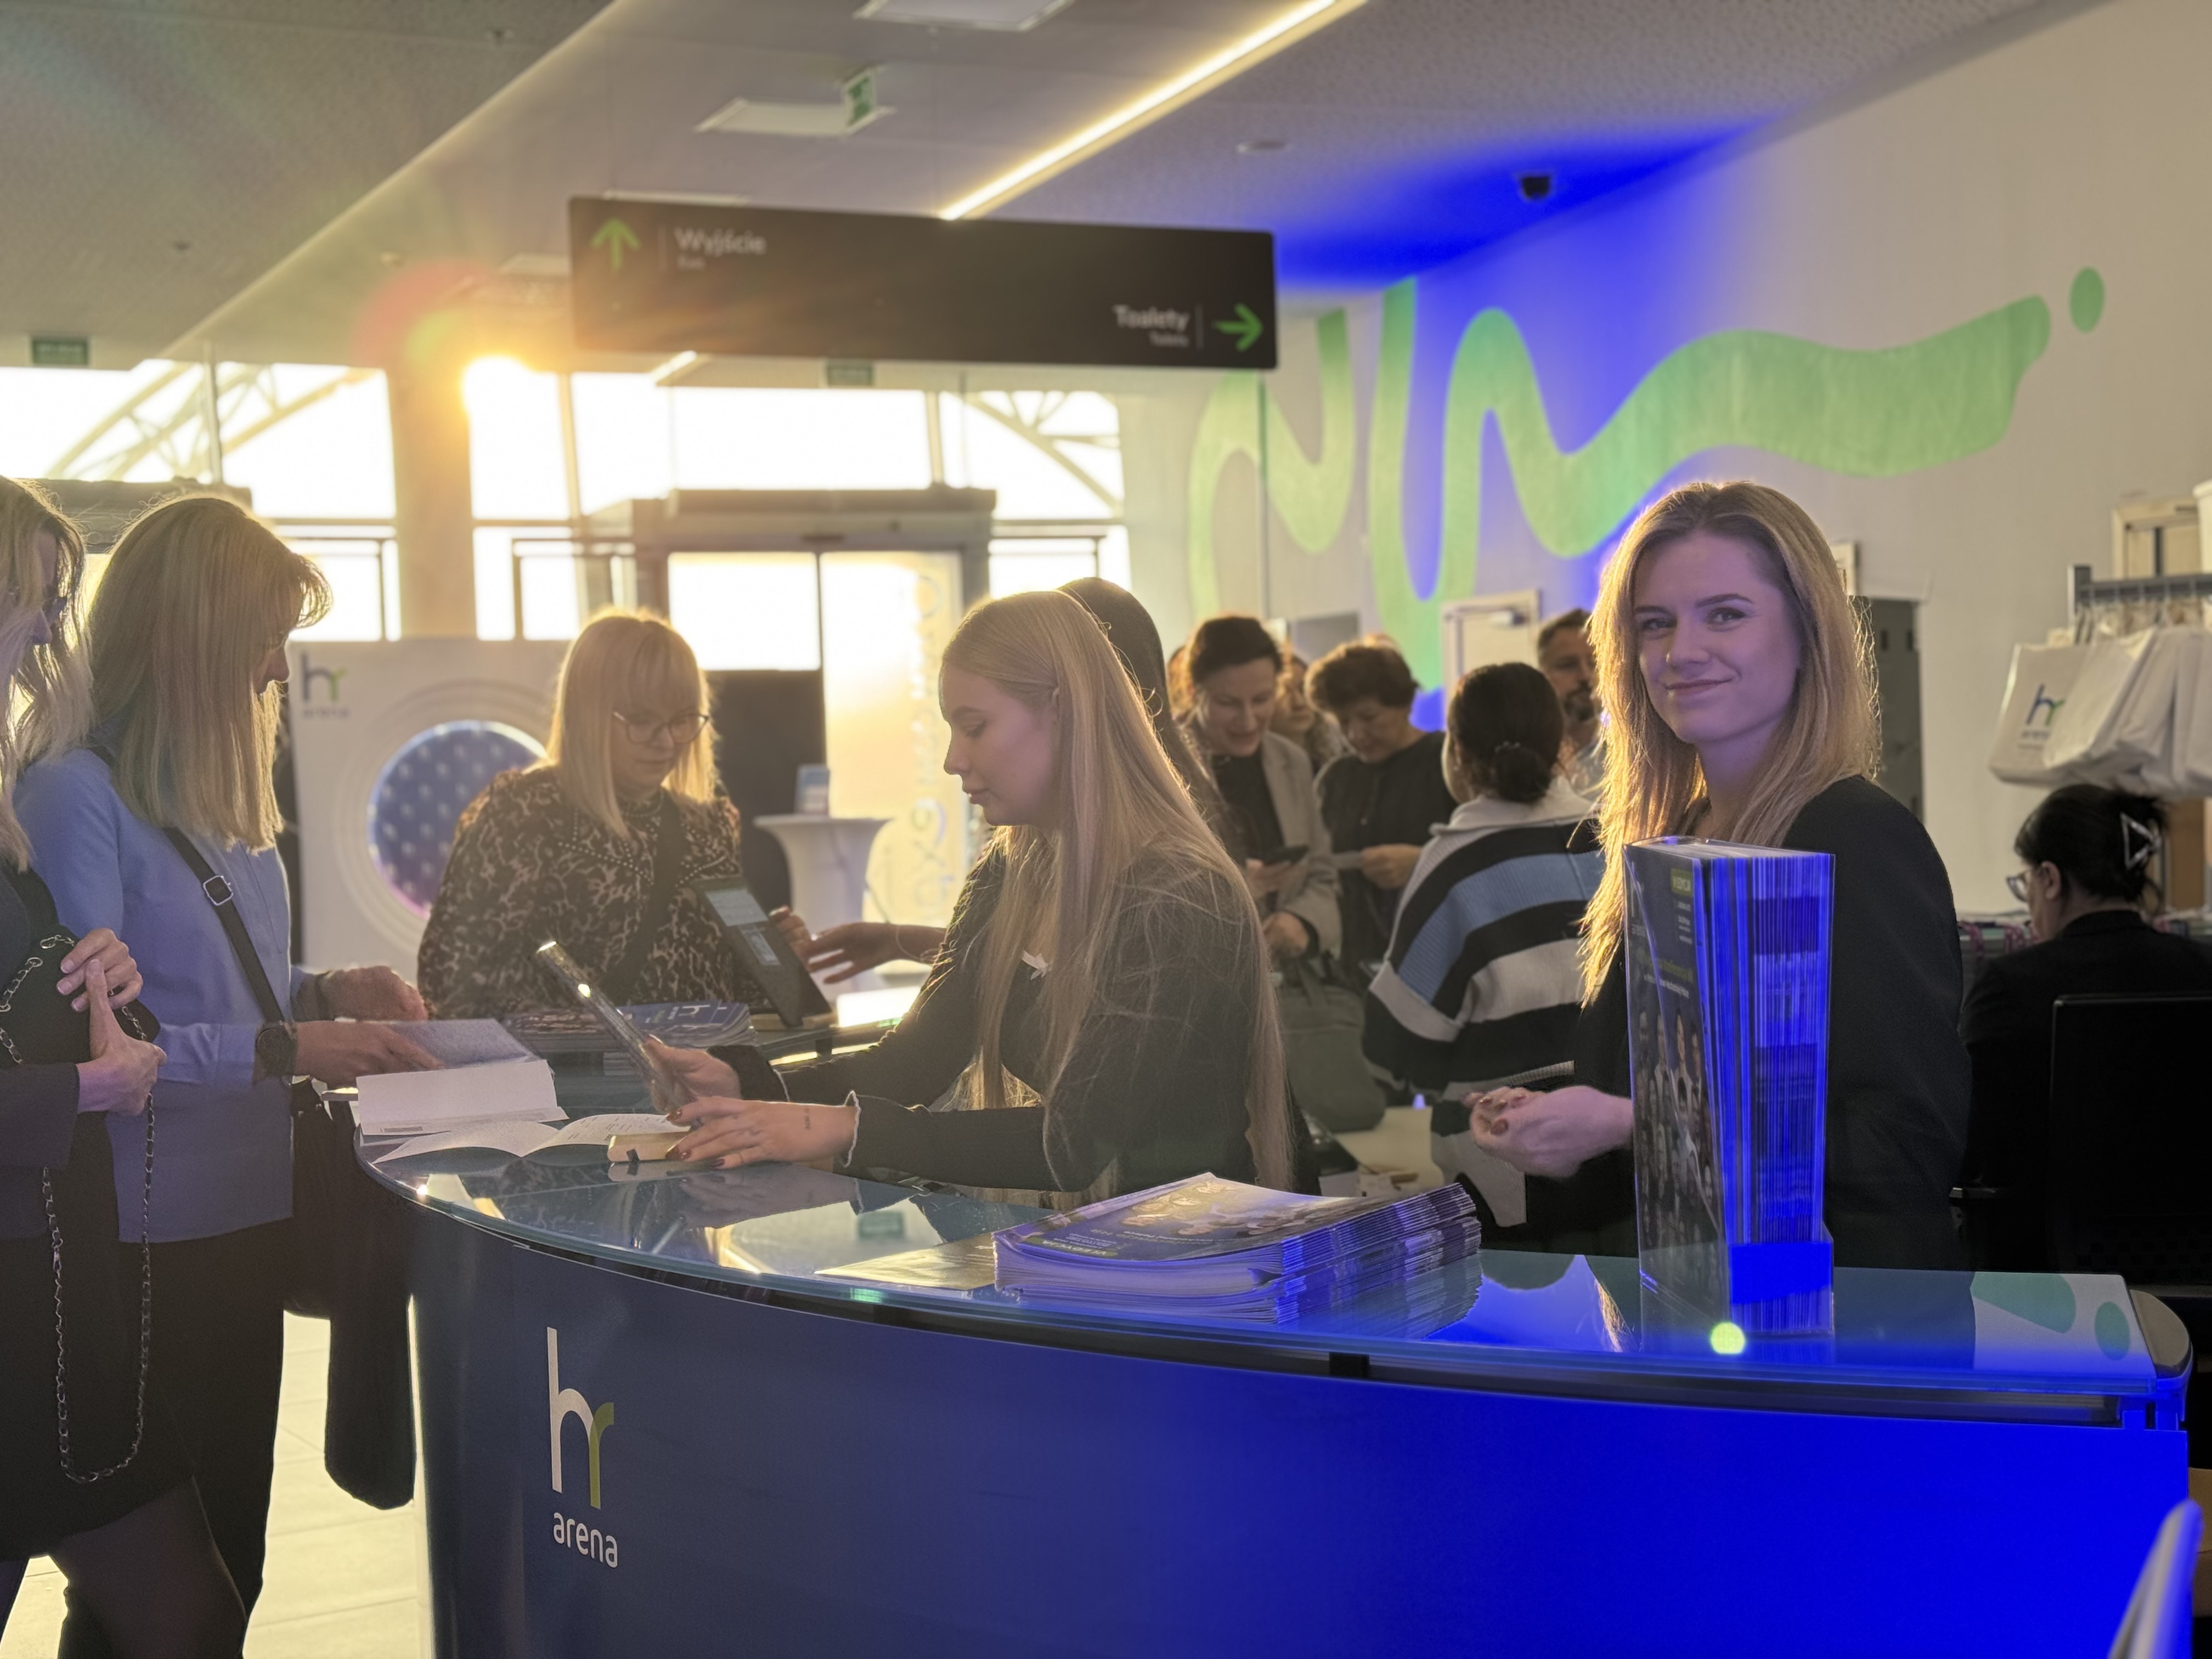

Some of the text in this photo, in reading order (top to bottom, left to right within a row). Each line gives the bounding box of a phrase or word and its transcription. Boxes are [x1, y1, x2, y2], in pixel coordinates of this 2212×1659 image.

[674, 228, 766, 257] Wyjście
[1113, 304, 1189, 332] Toalety
[547, 1327, 614, 1510] hr
[553, 1512, 618, 1568] arena
